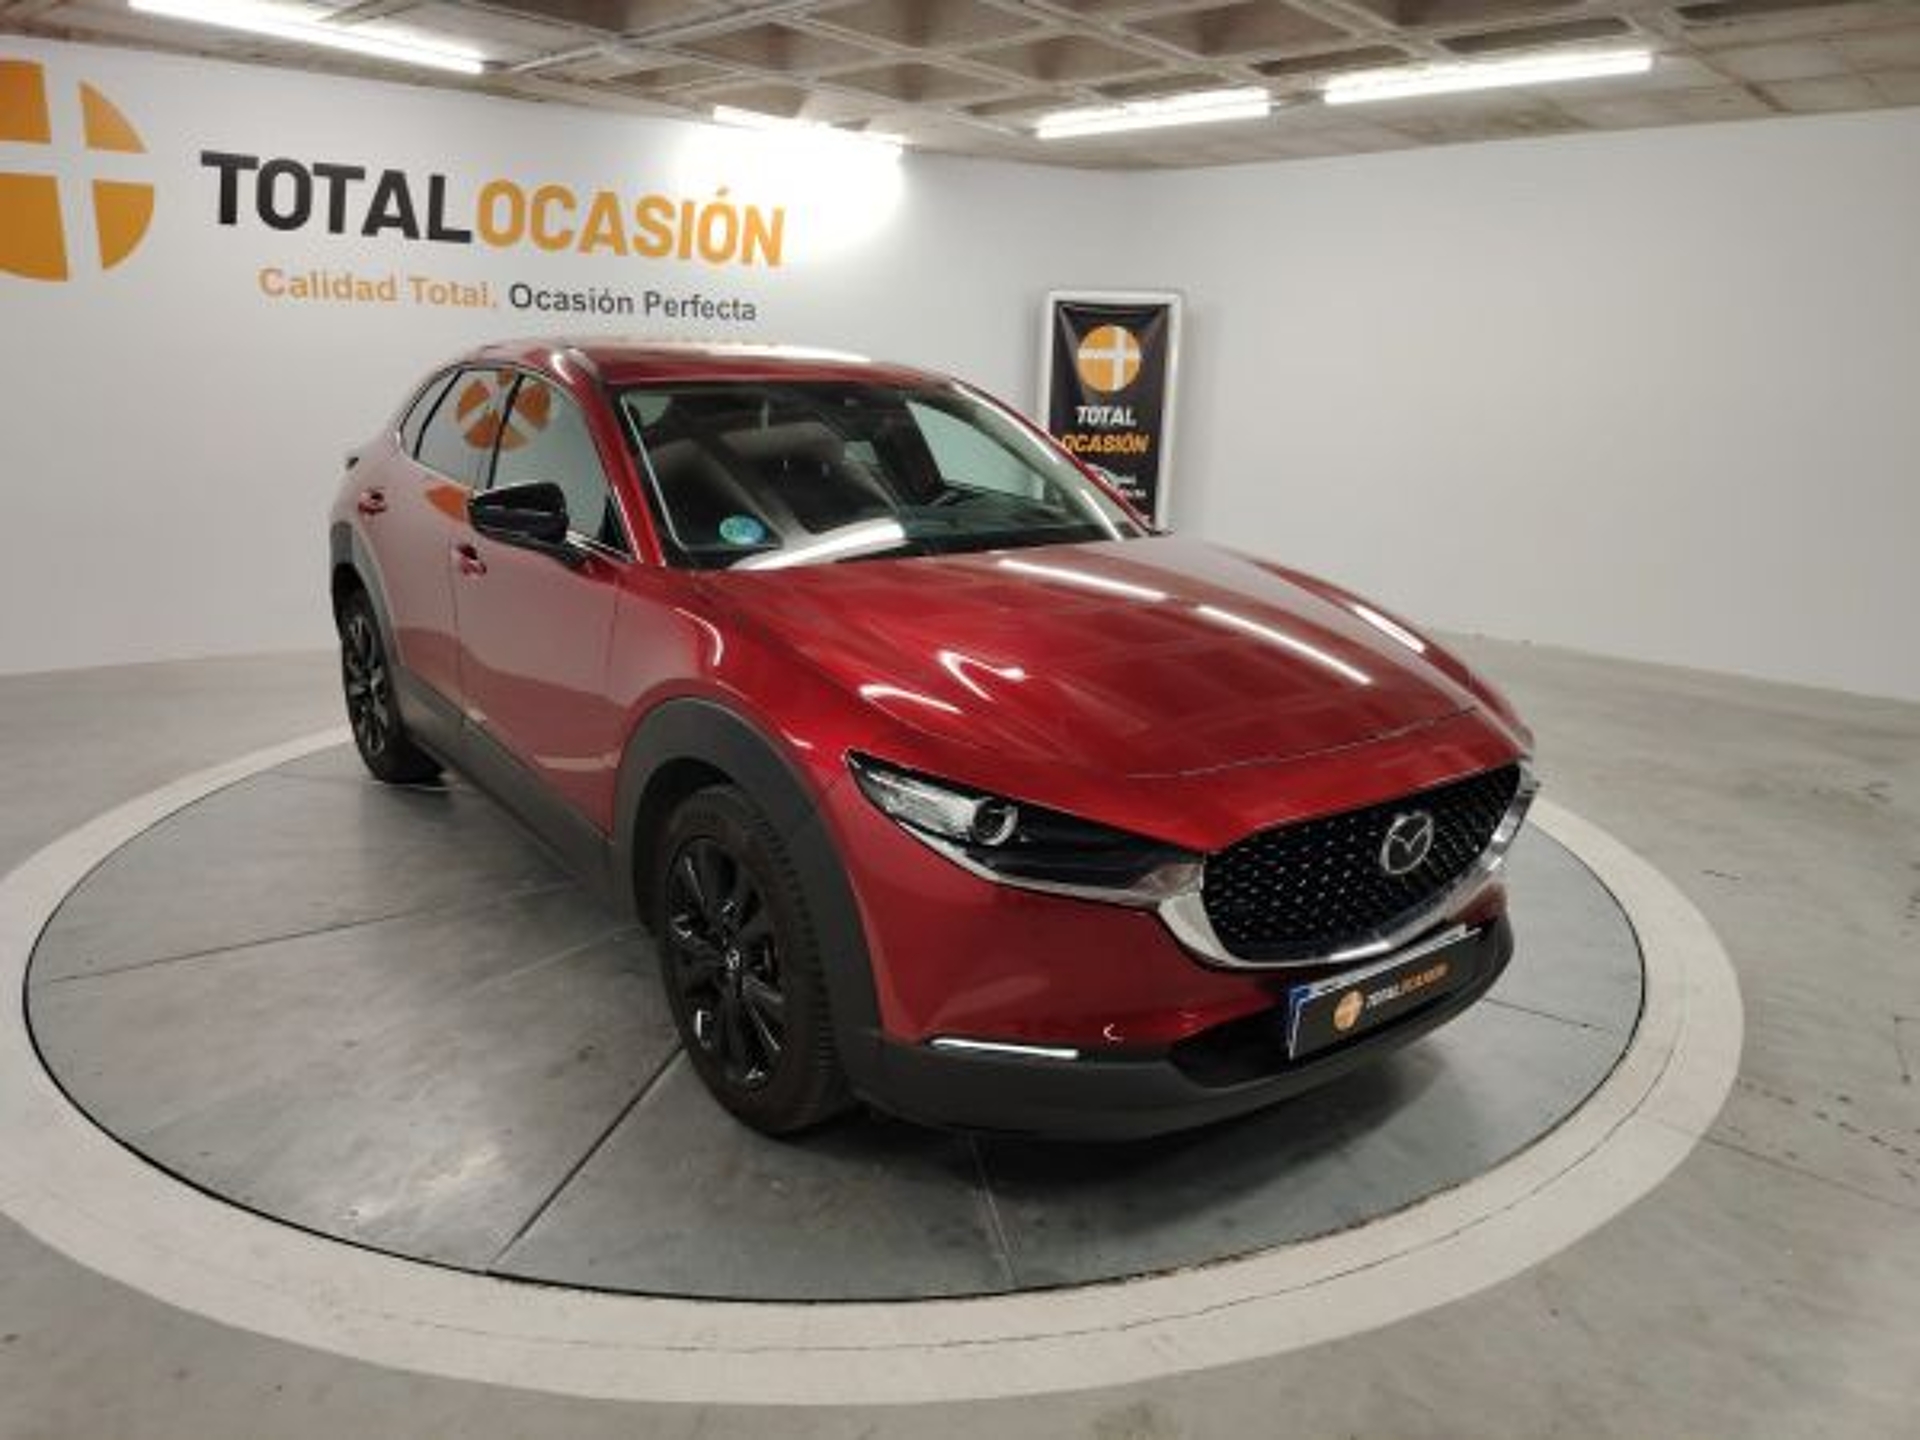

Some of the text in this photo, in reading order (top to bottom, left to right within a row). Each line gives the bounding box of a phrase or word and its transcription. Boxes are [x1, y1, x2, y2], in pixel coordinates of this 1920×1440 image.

[258, 267, 757, 322] Calidad Total. Ocasión Perfecta
[1076, 405, 1137, 427] TOTAL
[1366, 962, 1449, 1010] TOTALOCA
